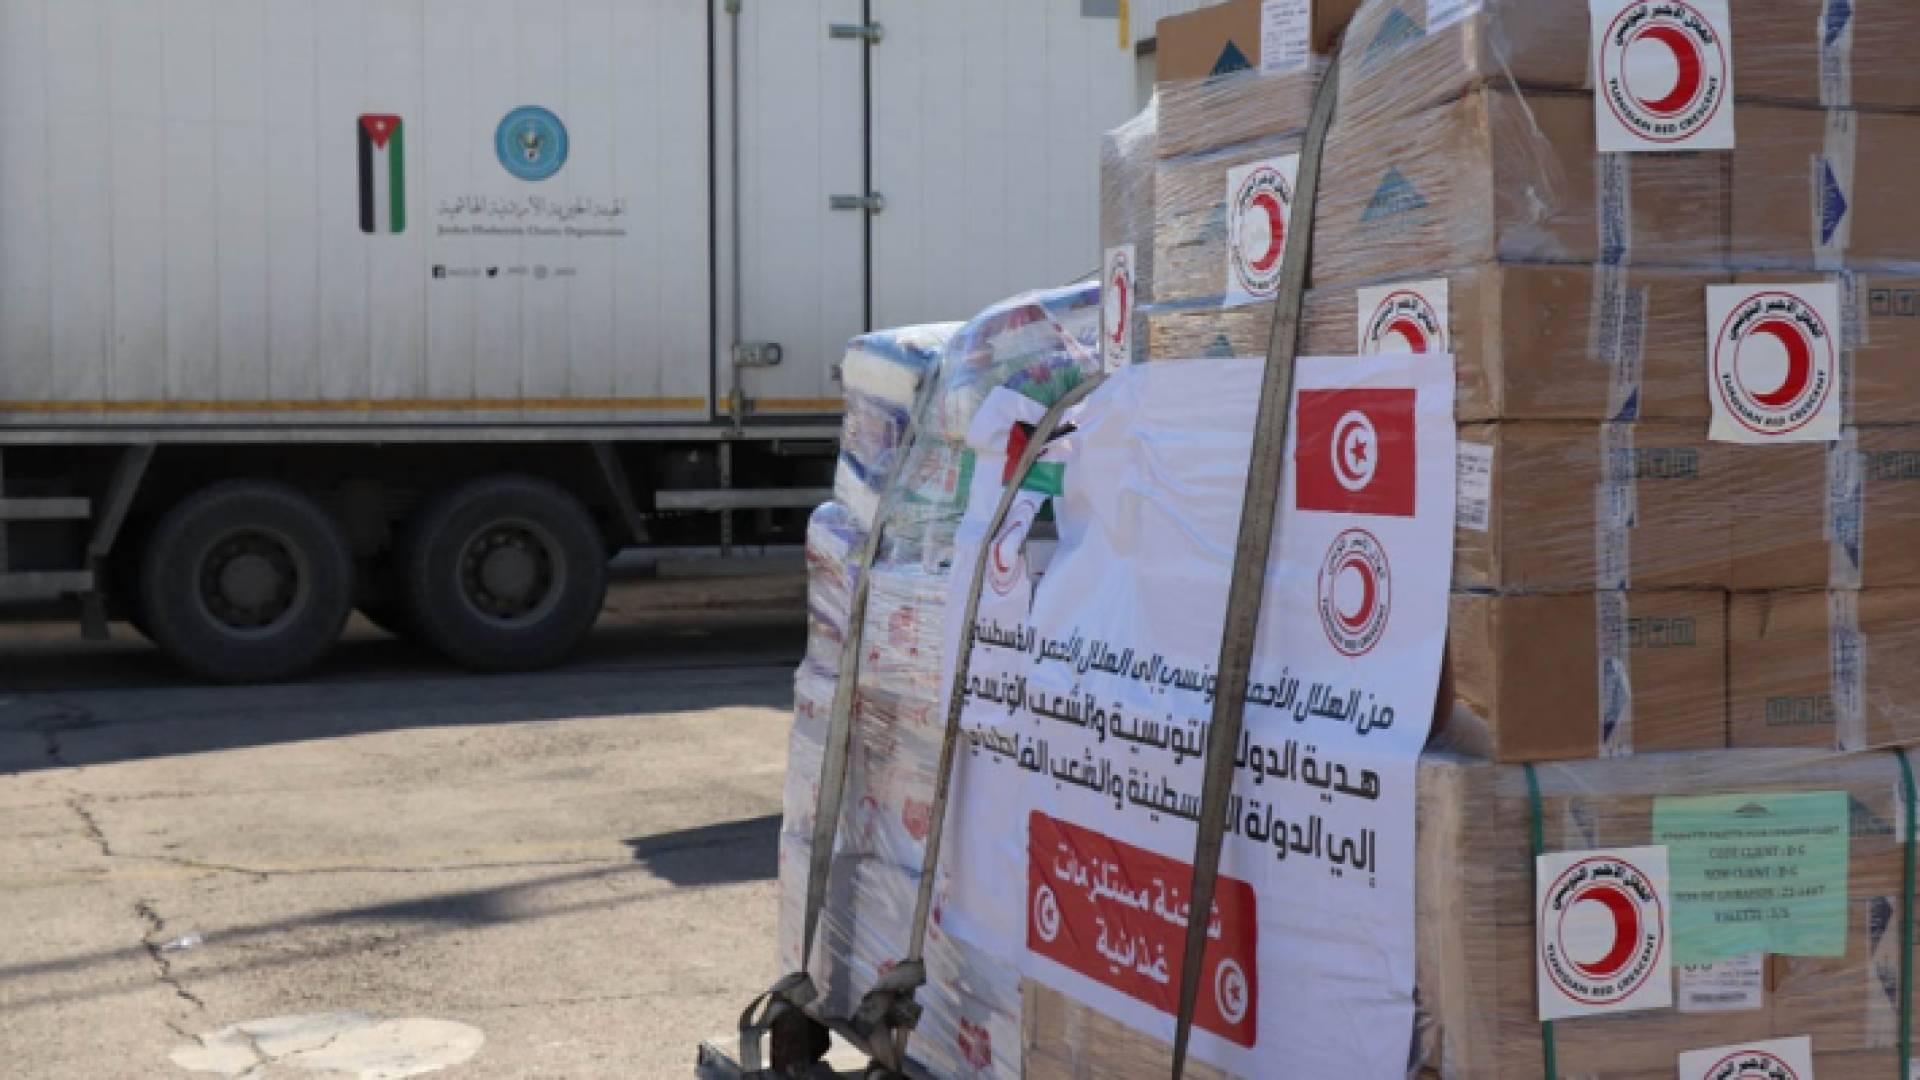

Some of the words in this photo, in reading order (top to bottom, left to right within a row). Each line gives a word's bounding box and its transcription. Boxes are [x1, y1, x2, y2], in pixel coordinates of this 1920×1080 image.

[1609, 78, 1650, 131] TUNISIAN
[1655, 124, 1677, 133] RED
[1680, 77, 1718, 130] CRESCENT
[1722, 371, 1762, 424] TUNISIAN
[1765, 417, 1786, 426] RED
[1790, 370, 1826, 422] CRESCENT
[1034, 627, 1084, 664] الأحمر
[1076, 640, 1133, 676] الهلال
[1028, 683, 1105, 742] والشعب
[1246, 666, 1299, 709] الأحم
[1293, 682, 1362, 722] الهلال
[1356, 693, 1395, 735] من
[1233, 730, 1297, 785] الدول
[1301, 744, 1380, 803] هدية
[1245, 800, 1321, 860] الدولة
[1053, 842, 1148, 910] مستلزمات
[1095, 916, 1170, 983] غذائية
[1547, 943, 1588, 994] TUNISIAN
[1592, 985, 1615, 996] RED
[1617, 933, 1655, 990] CRESCENT
